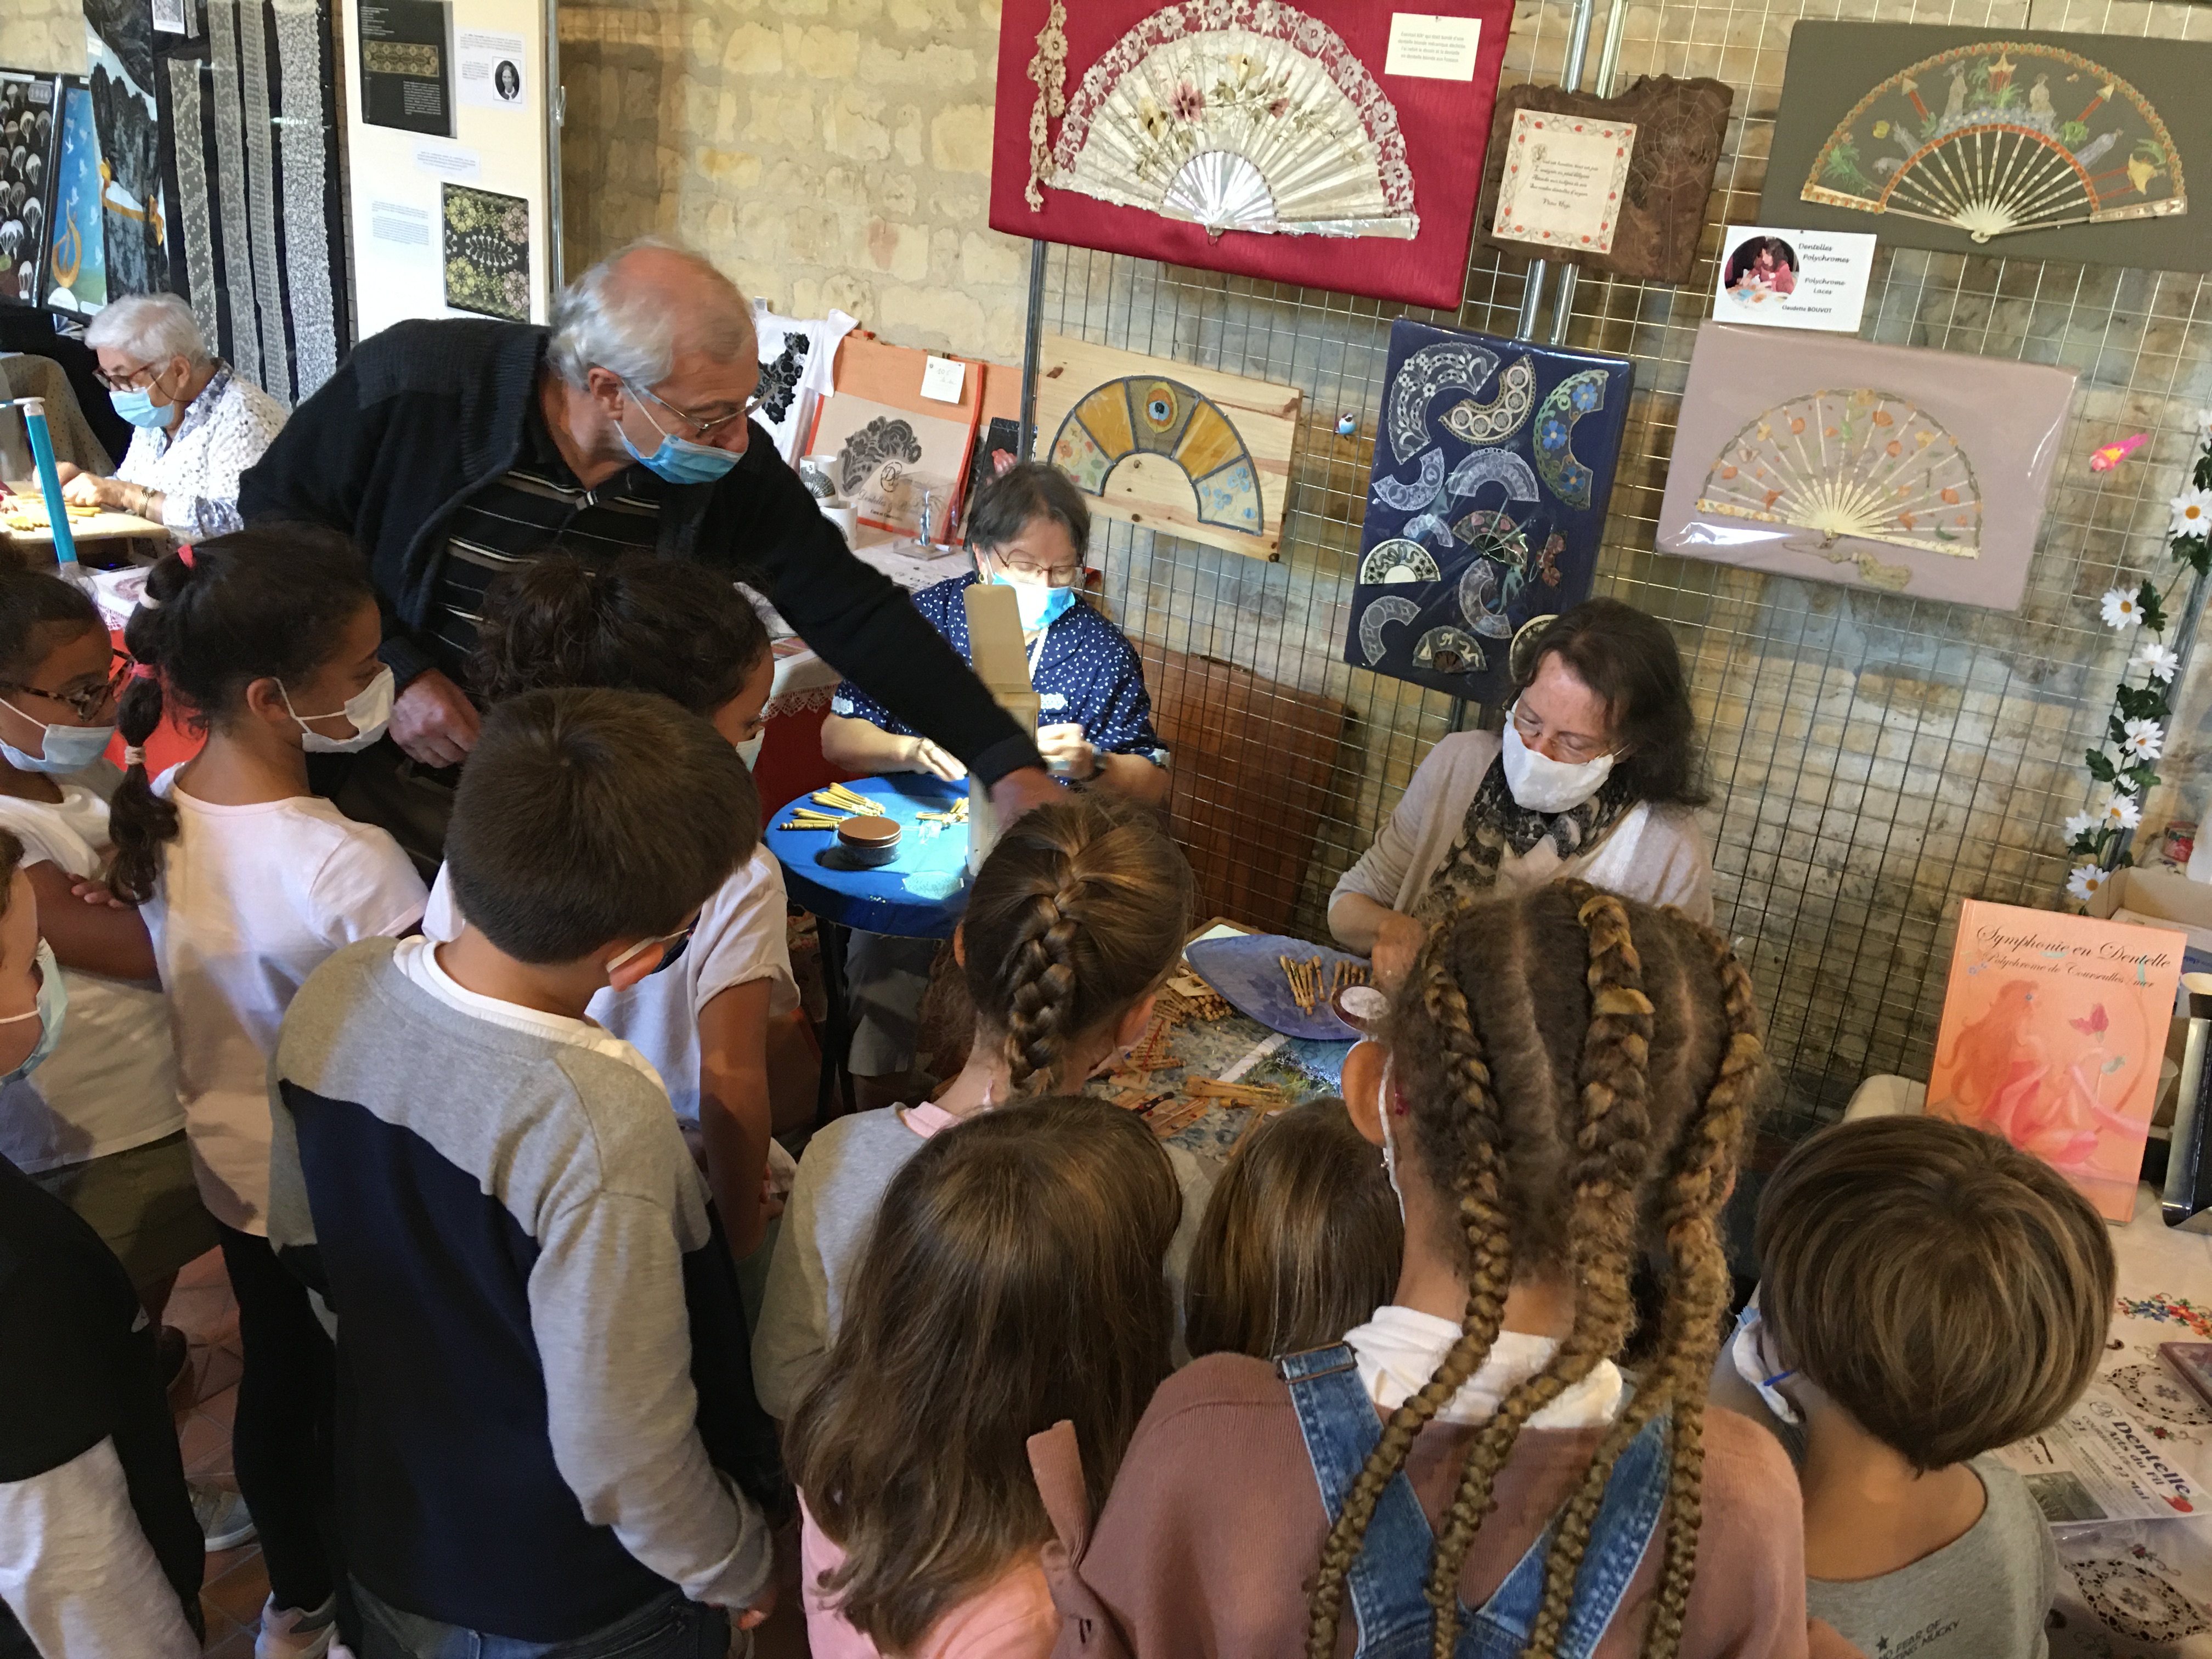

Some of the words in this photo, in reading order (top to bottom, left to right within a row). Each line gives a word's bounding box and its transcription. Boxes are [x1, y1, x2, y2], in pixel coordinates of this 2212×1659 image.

[1798, 243, 1833, 252] Dentelles
[1803, 254, 1850, 263] Polychromes
[1804, 278, 1846, 286] Polychrome
[1977, 924, 2070, 953] Symphonie
[2073, 946, 2091, 956] en
[2097, 941, 2170, 968] Dentelle
[1982, 952, 2046, 969] Polychrome
[2048, 963, 2061, 973] de
[2066, 962, 2124, 983] Courseulles
[2082, 1415, 2131, 1465] COURSEULLES
[2101, 1425, 2129, 1452] Arts
[2130, 1454, 2147, 1469] du
[2146, 1471, 2165, 1485] Fil
[2112, 1421, 2191, 1494] Dentelle
[2112, 1464, 2130, 1477] 22
[2126, 1480, 2150, 1500] Mai
[1896, 1630, 1923, 1653] FEAR
[1926, 1618, 1942, 1634] OF
[1921, 1618, 1960, 1647] MUCKY
